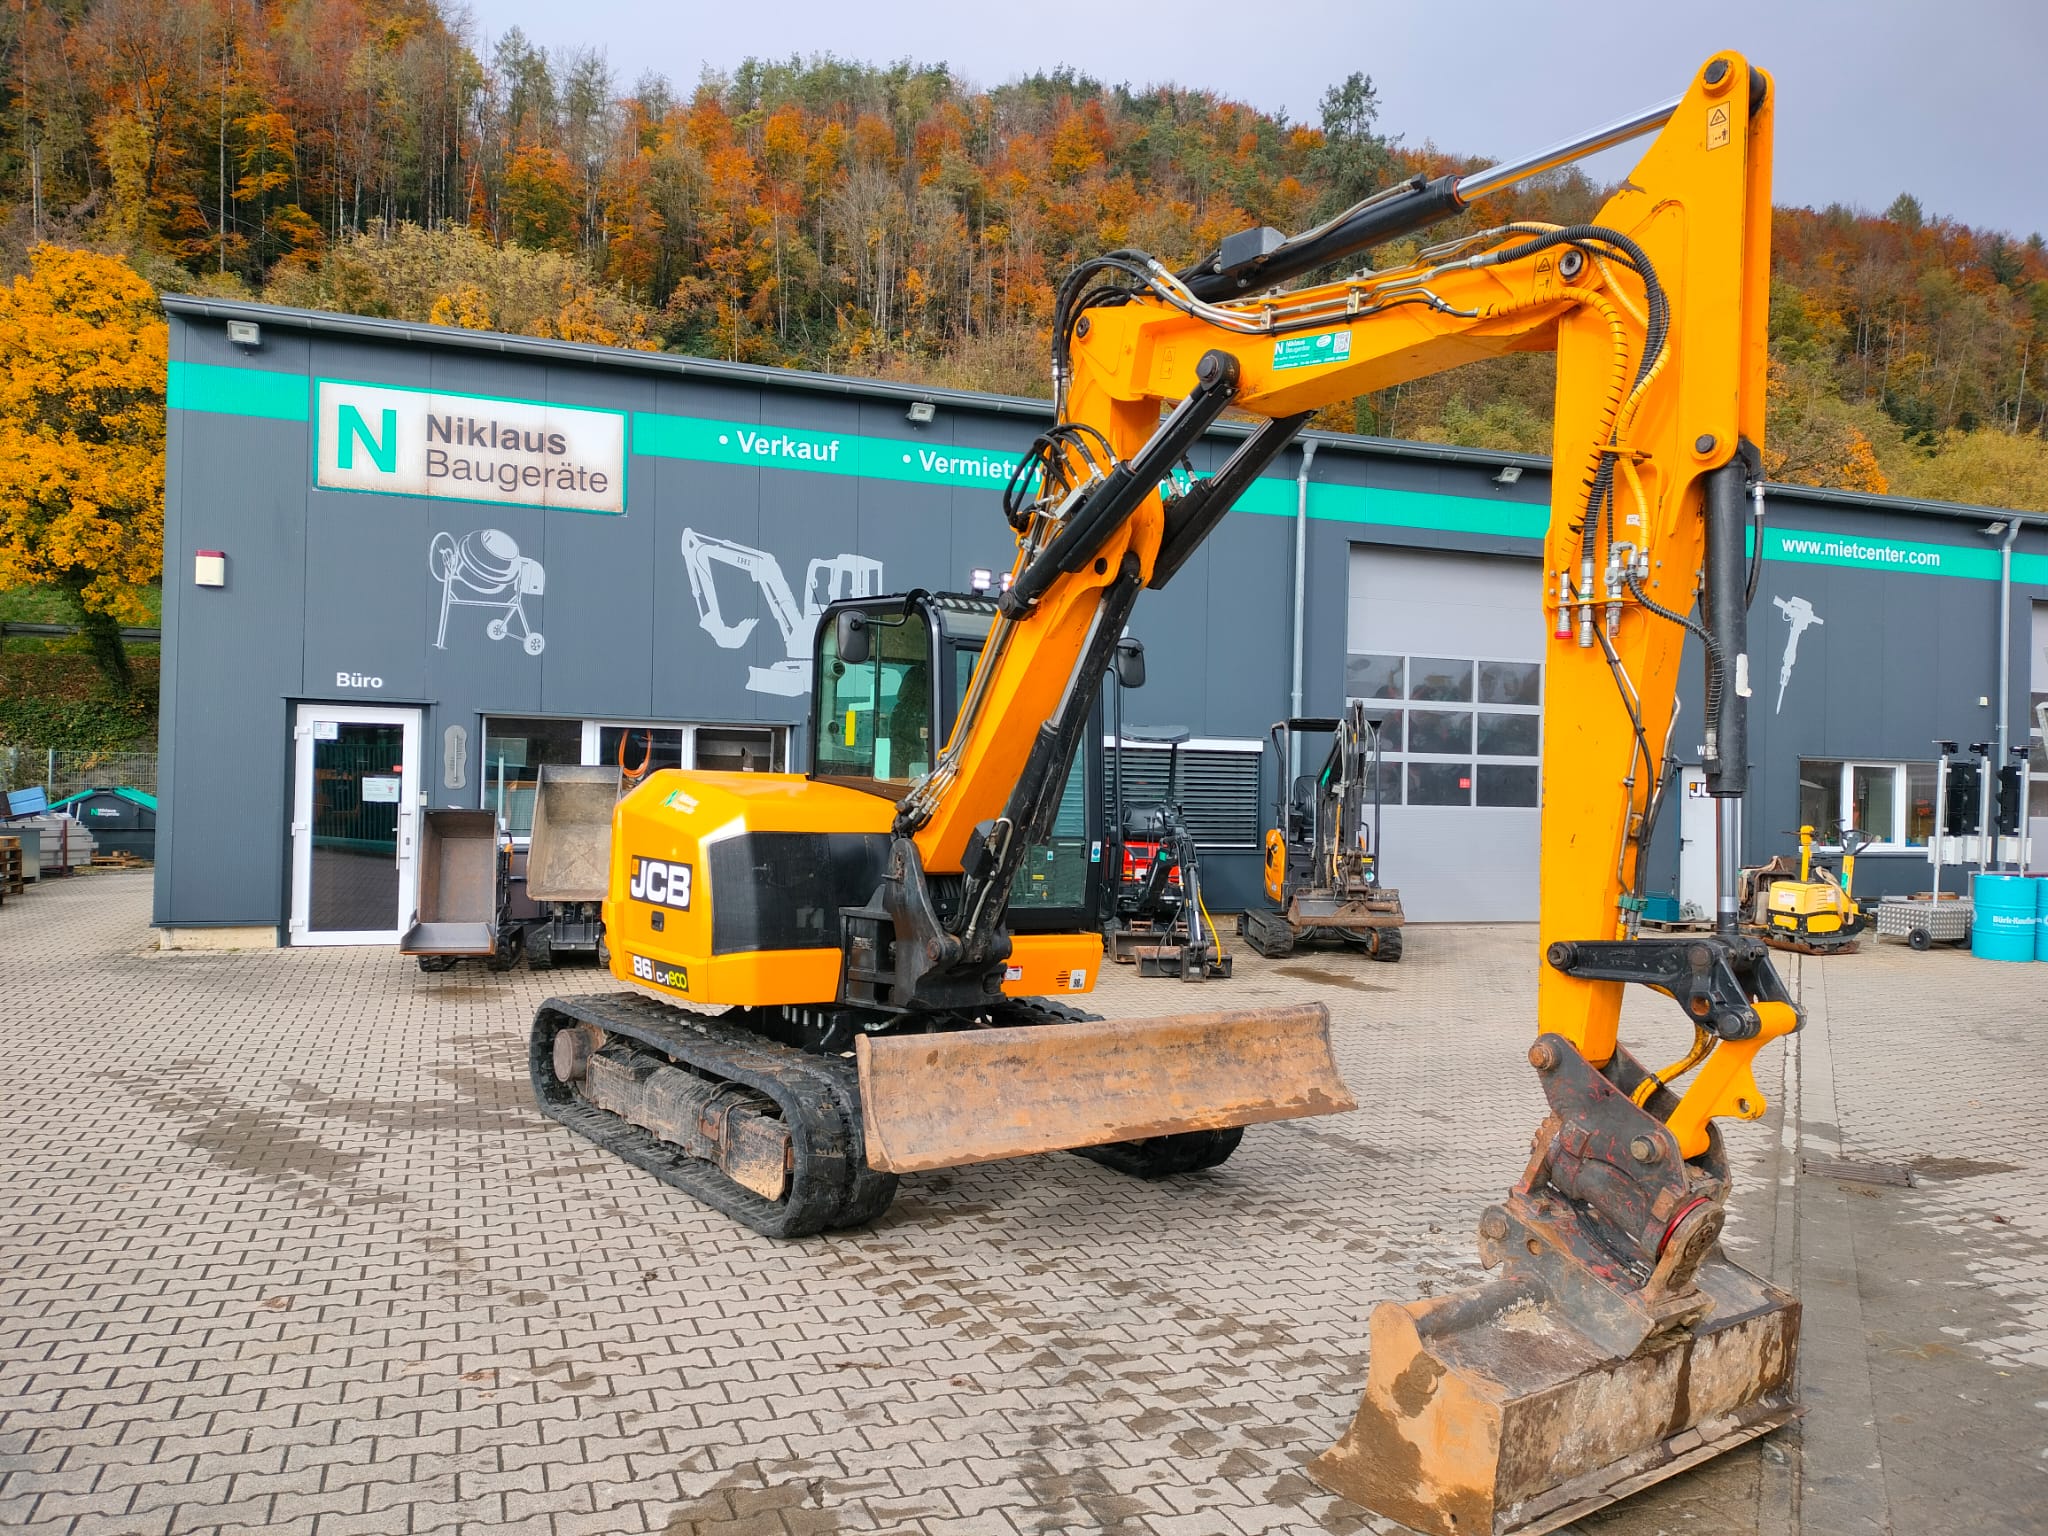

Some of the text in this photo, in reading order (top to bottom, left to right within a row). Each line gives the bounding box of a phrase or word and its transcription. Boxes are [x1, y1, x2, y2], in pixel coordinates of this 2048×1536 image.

[337, 404, 397, 474] N
[426, 413, 567, 456] Niklaus
[736, 430, 840, 463] Verkauf
[425, 448, 609, 494] Baugeräte
[1781, 538, 1941, 567] www.mietcenter.com
[336, 671, 383, 688] Büro
[630, 860, 690, 907] JCB
[633, 954, 653, 980] 86
